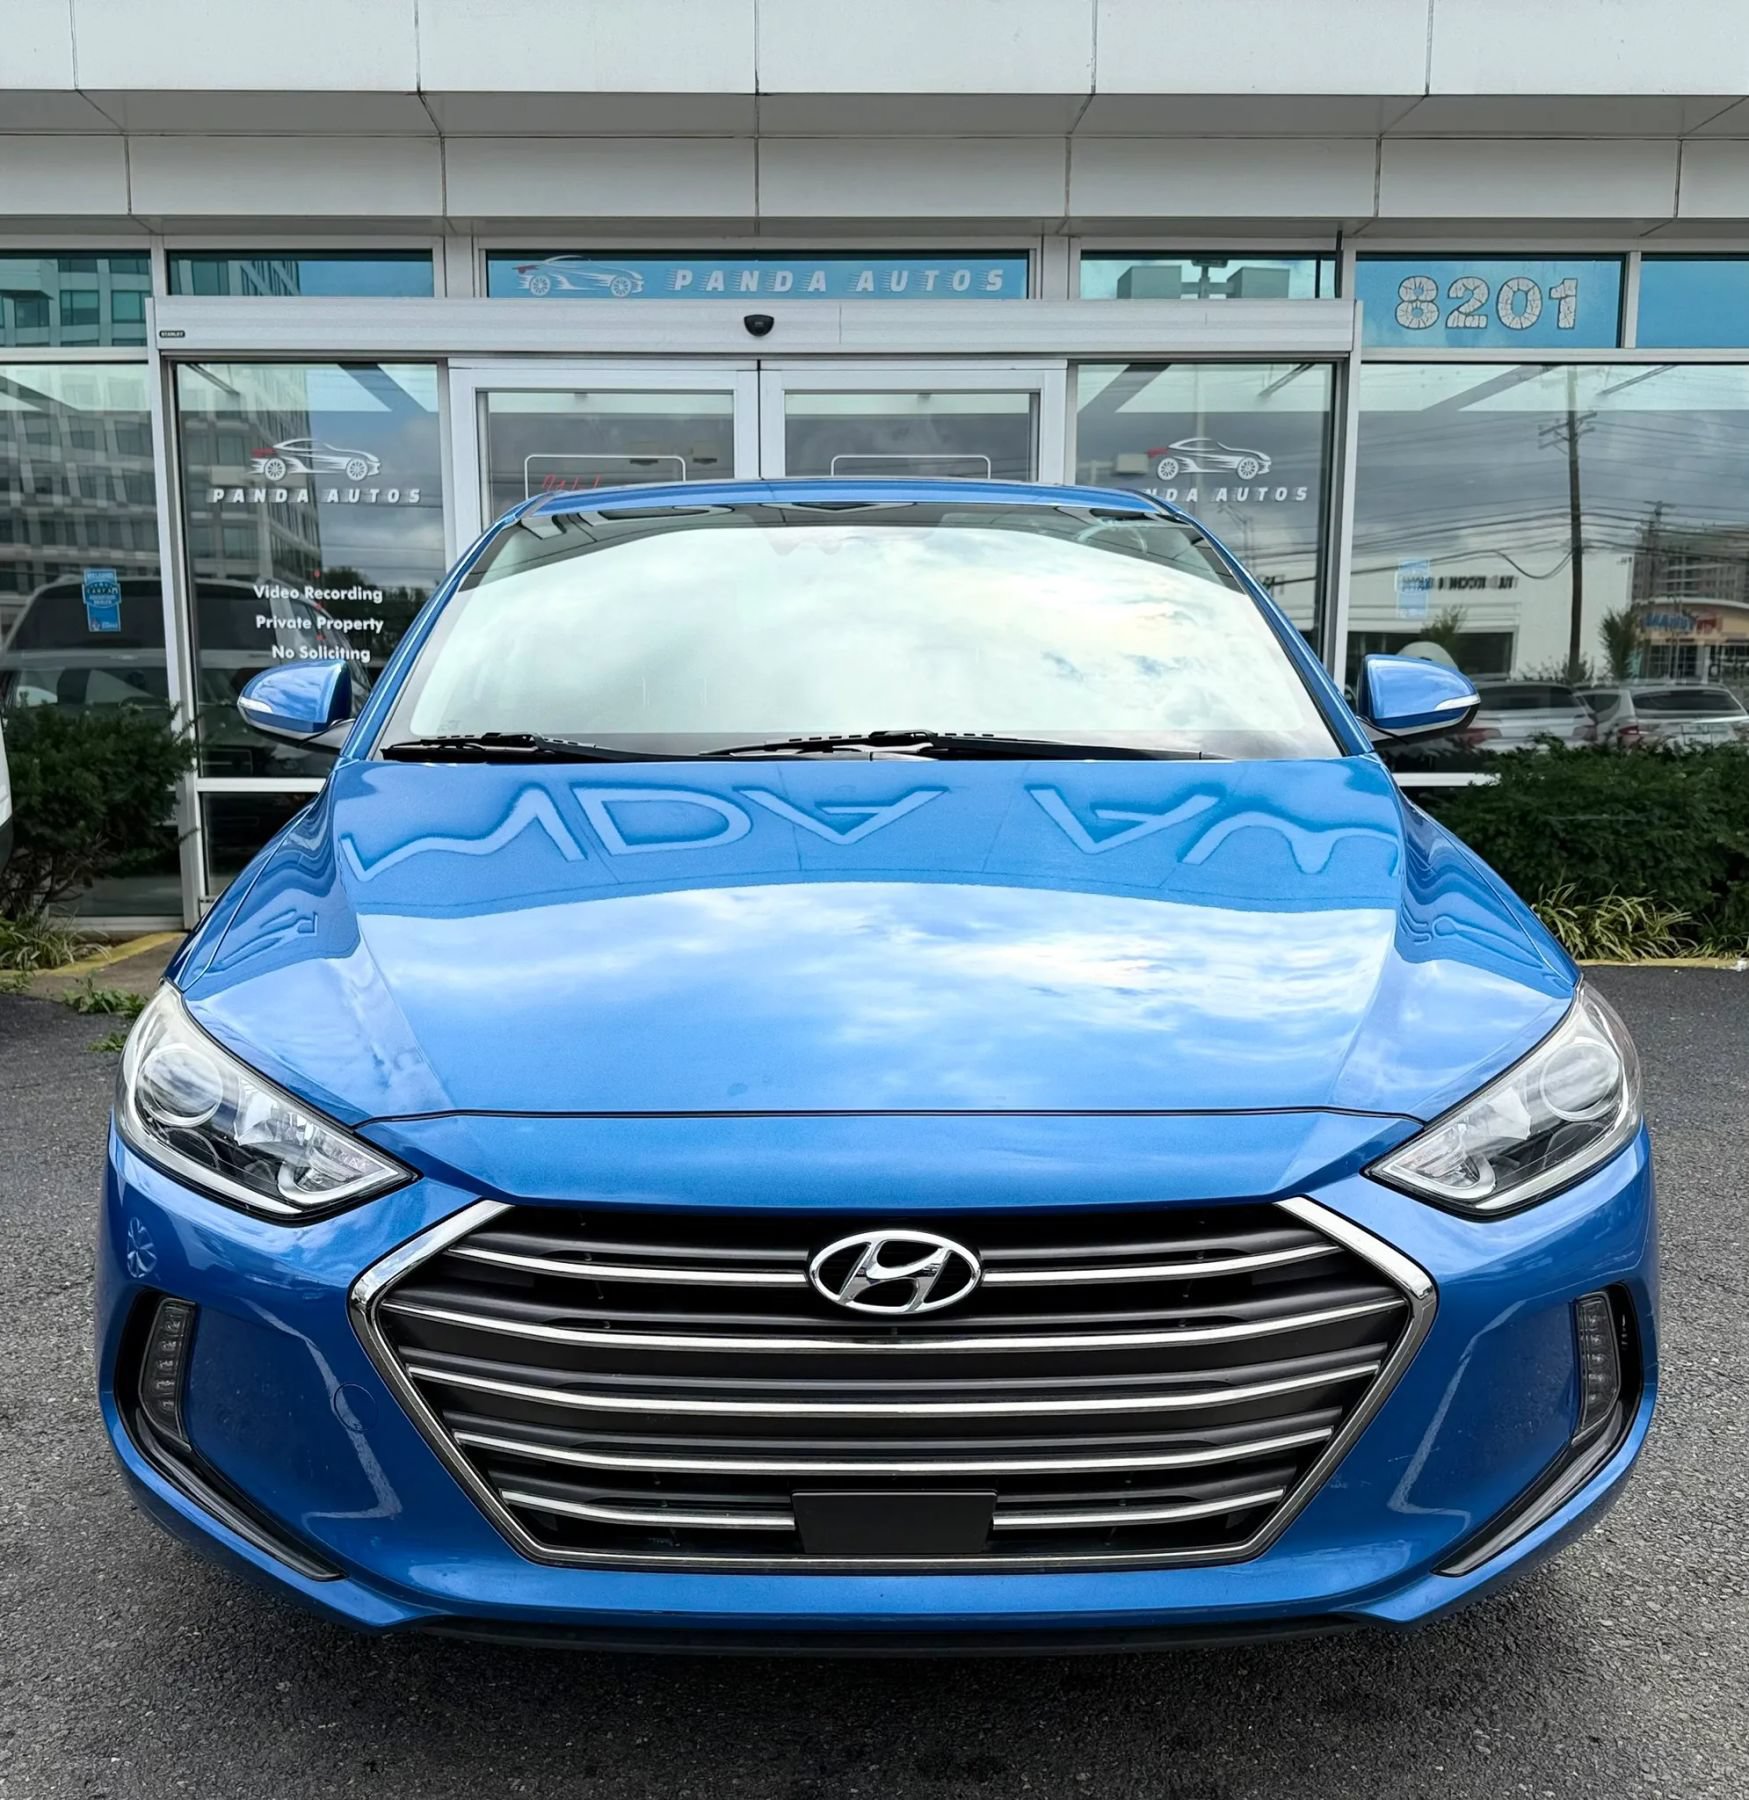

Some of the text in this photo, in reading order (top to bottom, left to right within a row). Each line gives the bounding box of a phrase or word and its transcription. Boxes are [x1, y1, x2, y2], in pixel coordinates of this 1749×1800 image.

[671, 269, 1003, 292] PANDA AUTOS
[1395, 275, 1578, 330] 8201
[211, 488, 420, 504] PANDA AUTOS
[1144, 487, 1307, 502] NDA AUTOS
[253, 584, 383, 604] Video Recording
[256, 615, 383, 634] Private Property
[272, 645, 371, 663] No Soliciting
